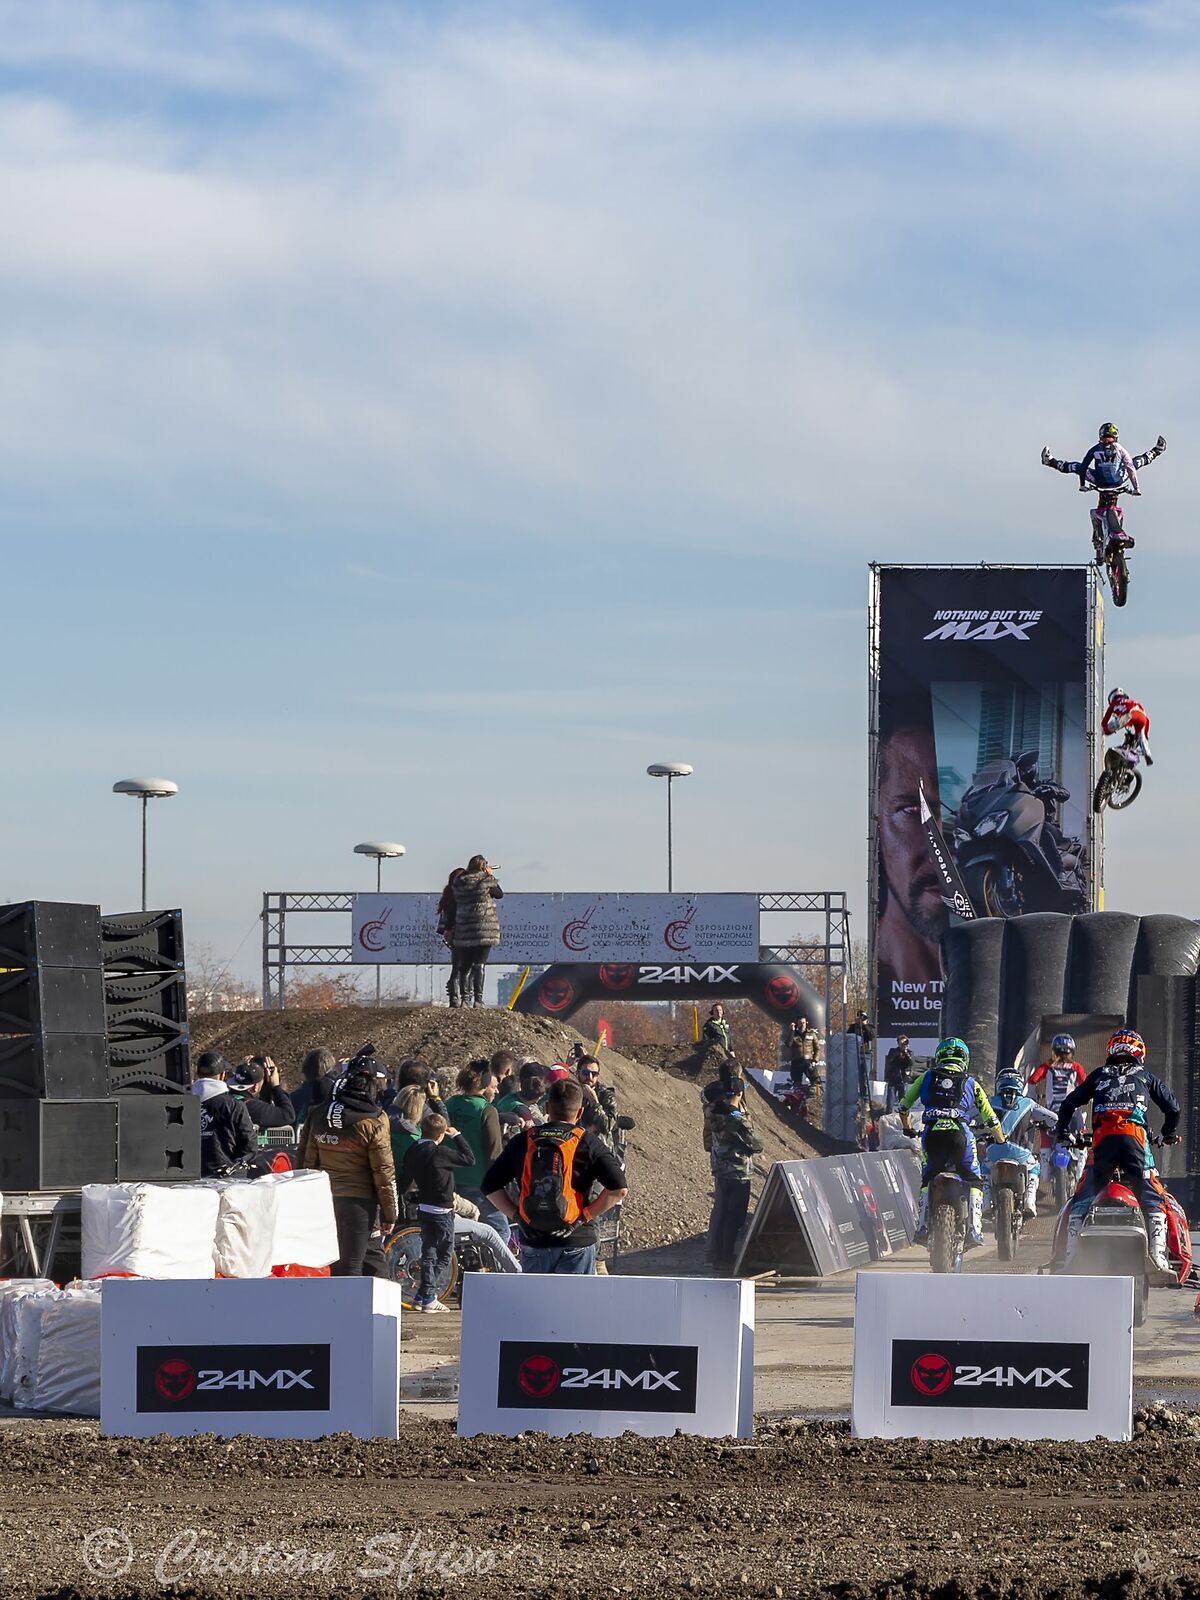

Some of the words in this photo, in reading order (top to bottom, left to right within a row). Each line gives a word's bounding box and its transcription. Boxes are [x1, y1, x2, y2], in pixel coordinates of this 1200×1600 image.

[933, 610, 989, 620] NOTHING
[990, 610, 1017, 620] BUT
[1018, 610, 1043, 620] THE
[923, 621, 1038, 640] MAX
[638, 965, 741, 983] 24MX
[891, 980, 926, 993] New
[891, 997, 919, 1010] You
[196, 1369, 315, 1390] 24MX
[560, 1367, 681, 1391] 24MX
[953, 1366, 1073, 1388] 24MX
